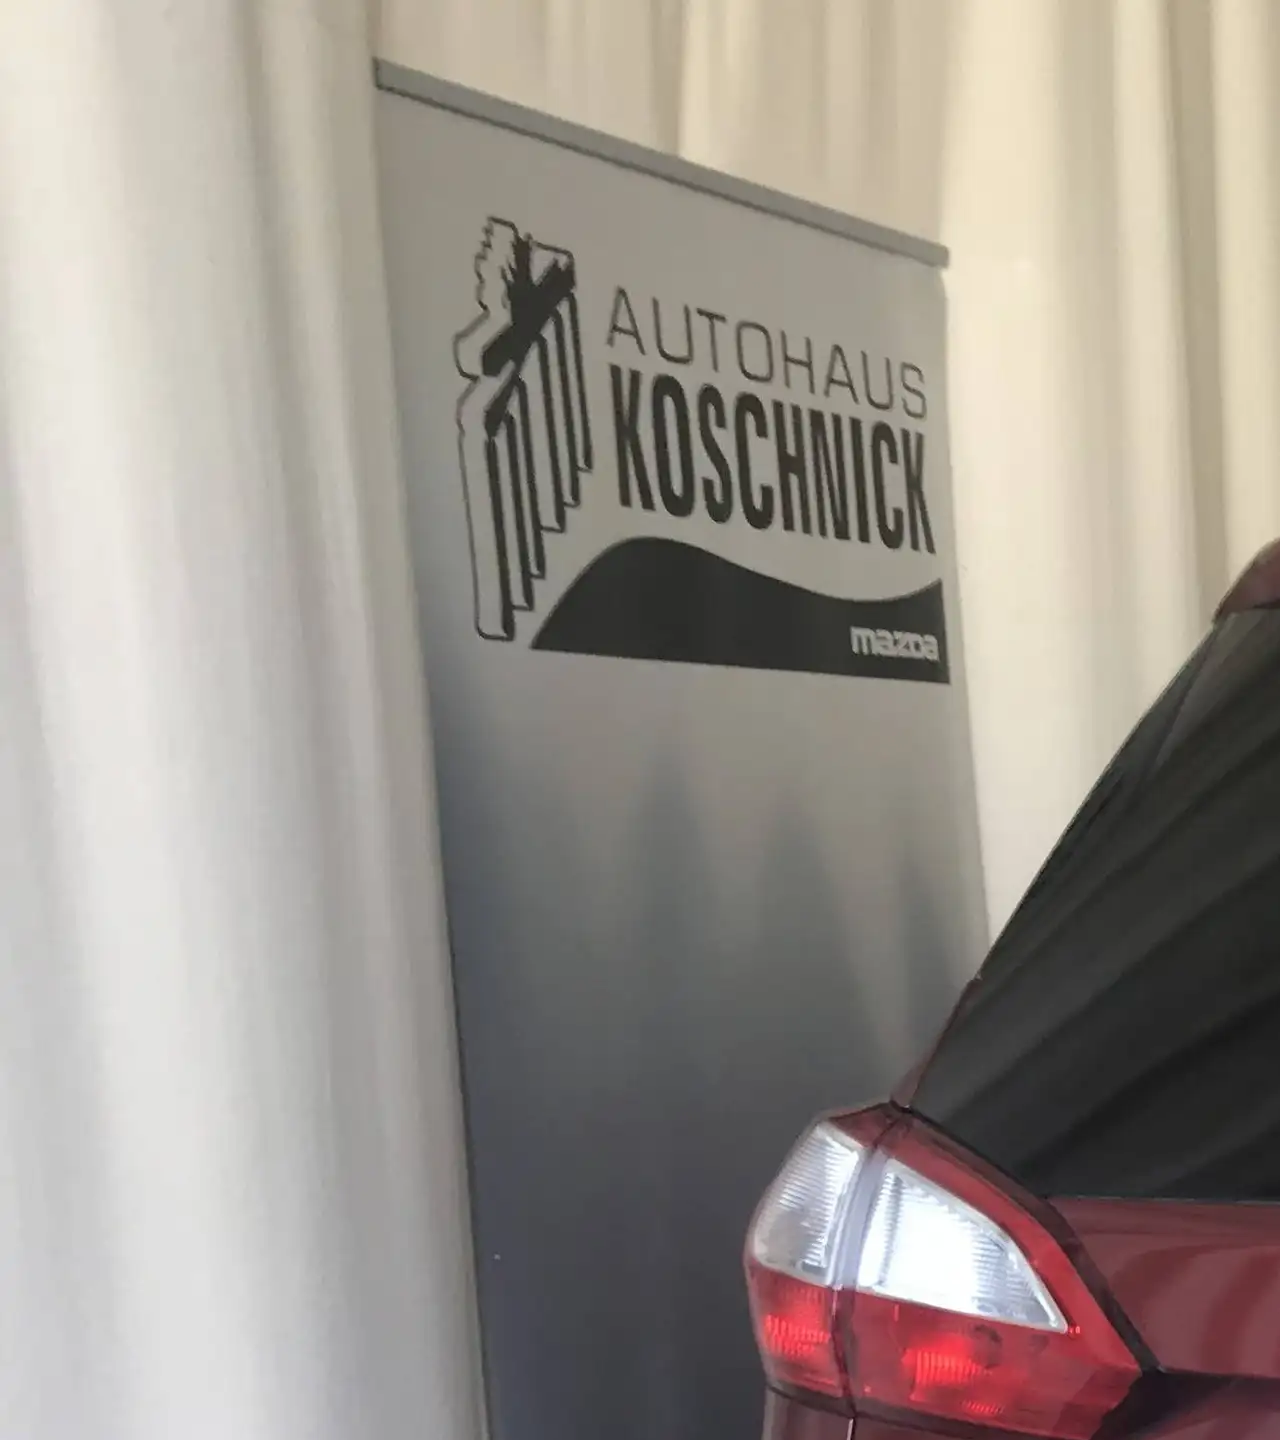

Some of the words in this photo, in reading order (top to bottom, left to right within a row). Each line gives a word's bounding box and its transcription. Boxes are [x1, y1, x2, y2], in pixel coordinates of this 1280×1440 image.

[605, 285, 928, 420] AUTOHAUS
[608, 363, 937, 556] KOSCHNICK
[849, 626, 940, 661] mazda
